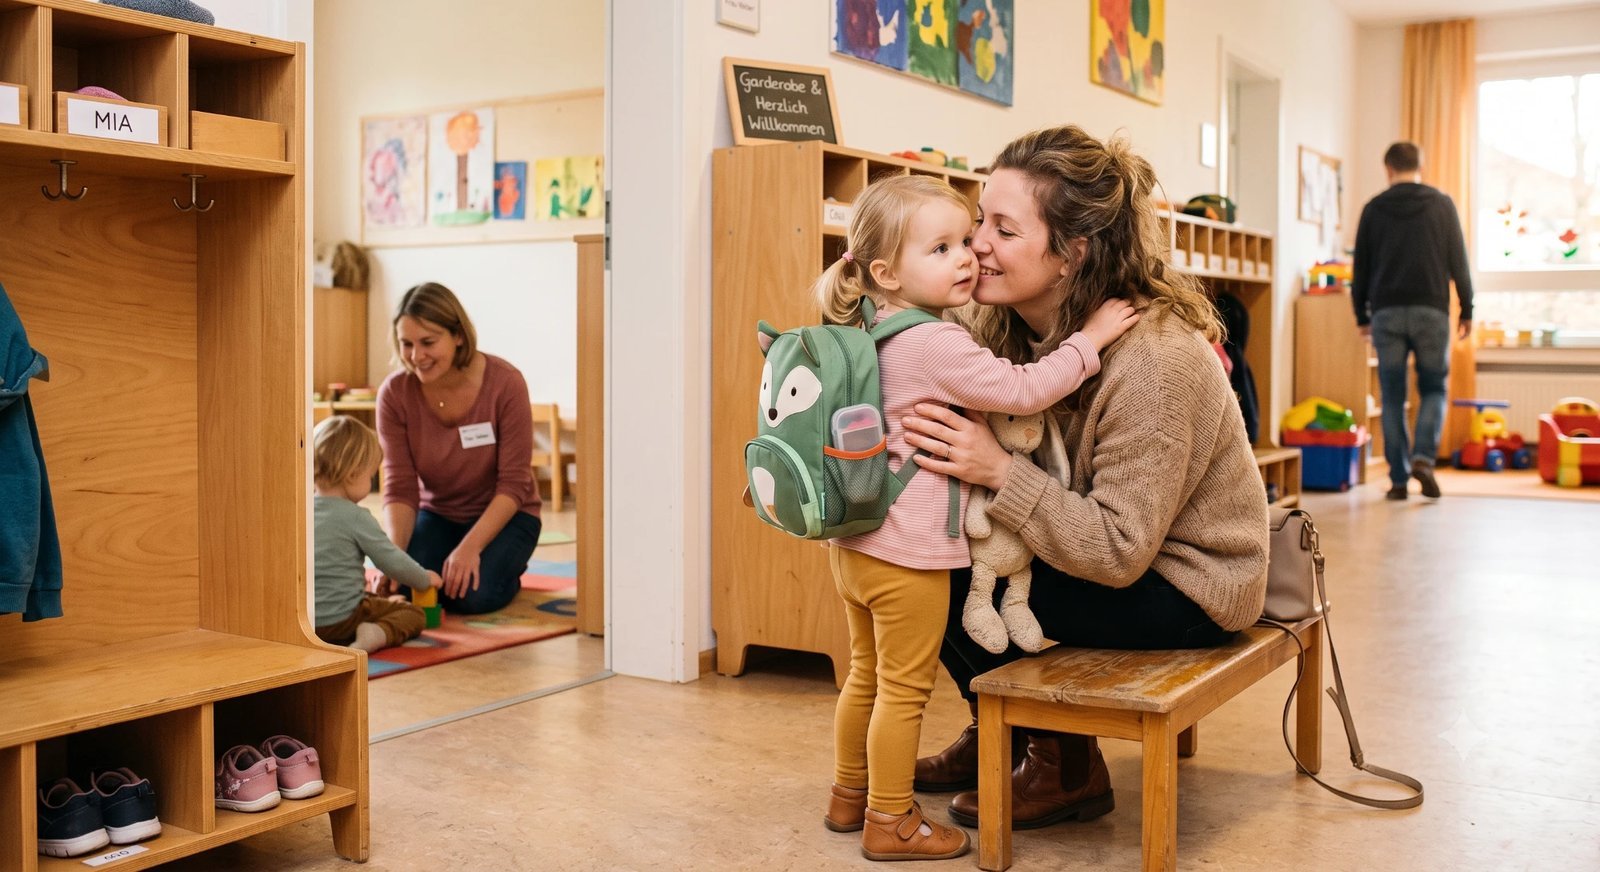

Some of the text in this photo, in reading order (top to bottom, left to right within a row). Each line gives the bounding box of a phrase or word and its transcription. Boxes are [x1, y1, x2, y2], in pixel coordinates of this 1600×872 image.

[739, 71, 822, 95] Garderobe &
[755, 96, 808, 114] Herzlich
[95, 110, 133, 133] MIA
[748, 114, 825, 136] Willkommen
